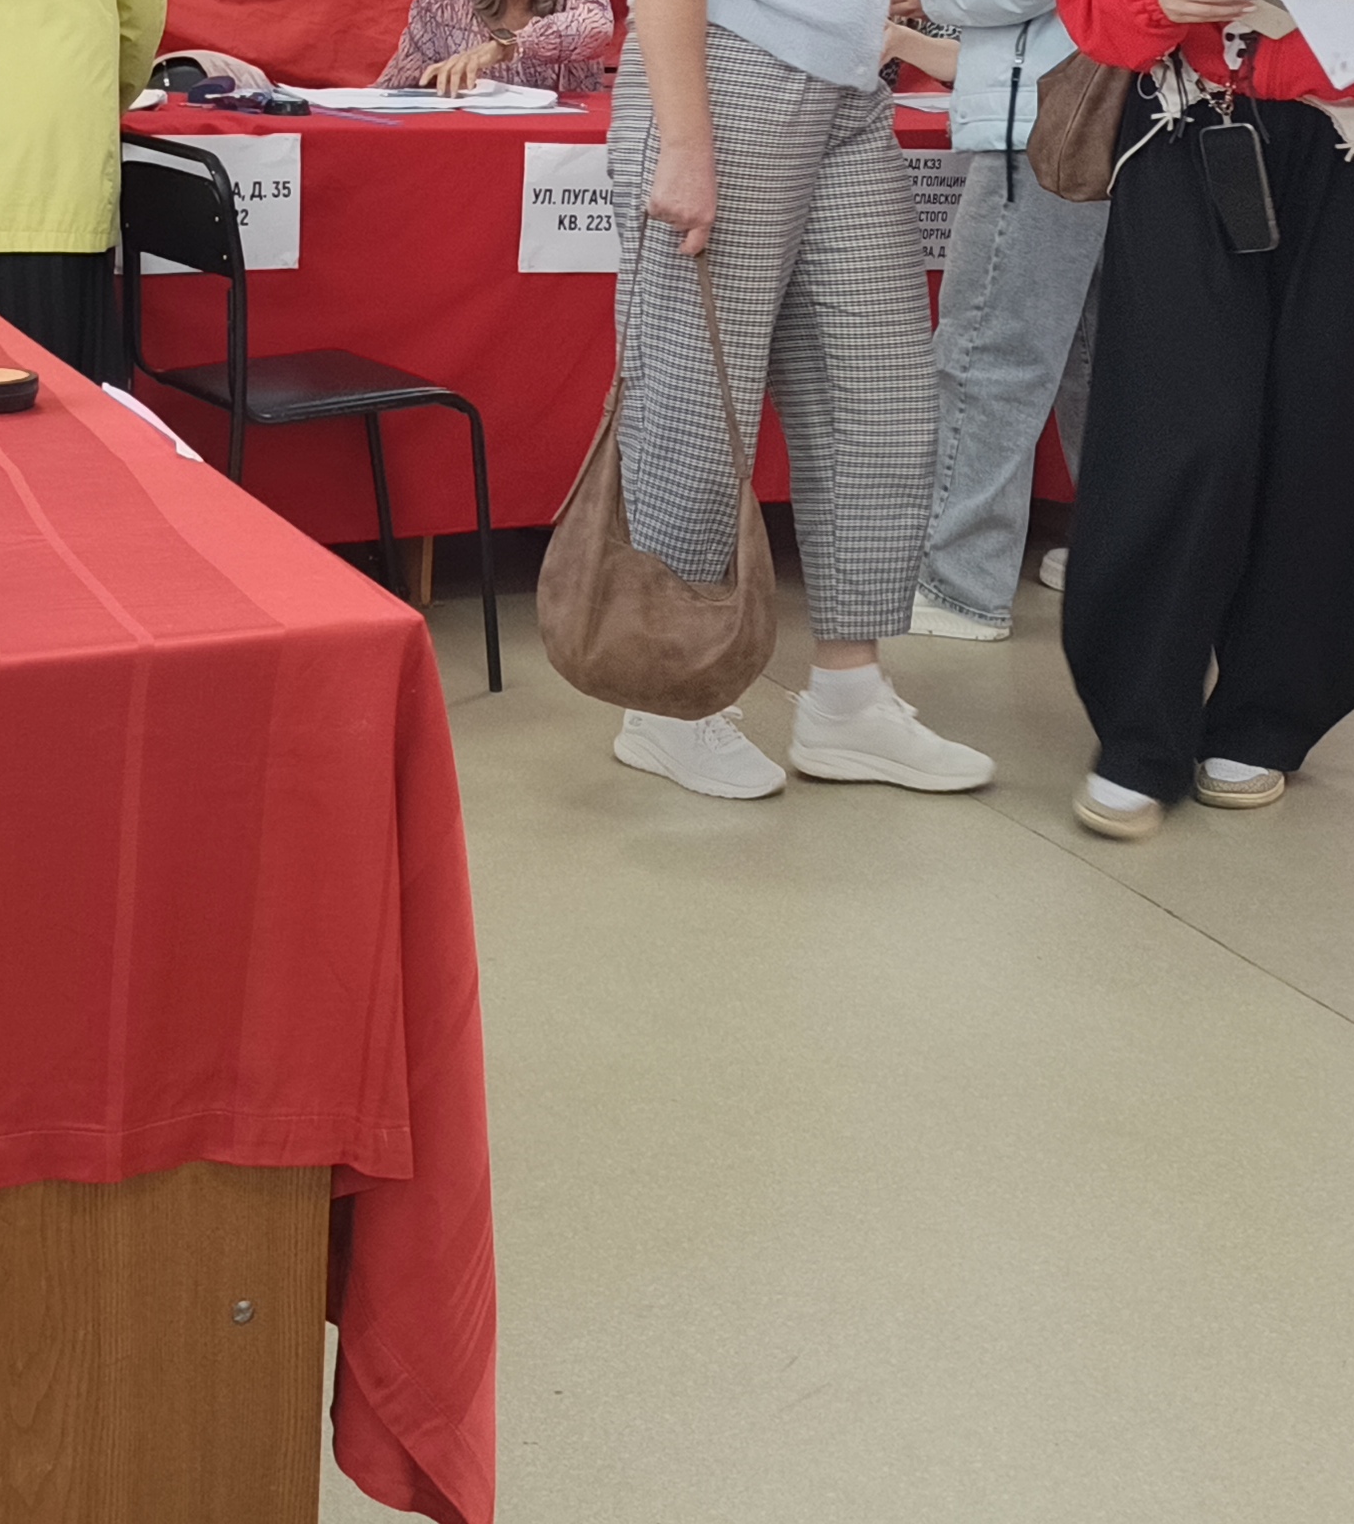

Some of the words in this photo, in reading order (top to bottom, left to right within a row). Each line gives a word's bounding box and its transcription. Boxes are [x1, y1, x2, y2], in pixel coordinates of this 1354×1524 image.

[249, 181, 267, 201] Д.
[271, 180, 292, 198] 35
[532, 187, 557, 205] УЛ.
[557, 214, 582, 232] КВ.
[585, 214, 613, 232] 223
